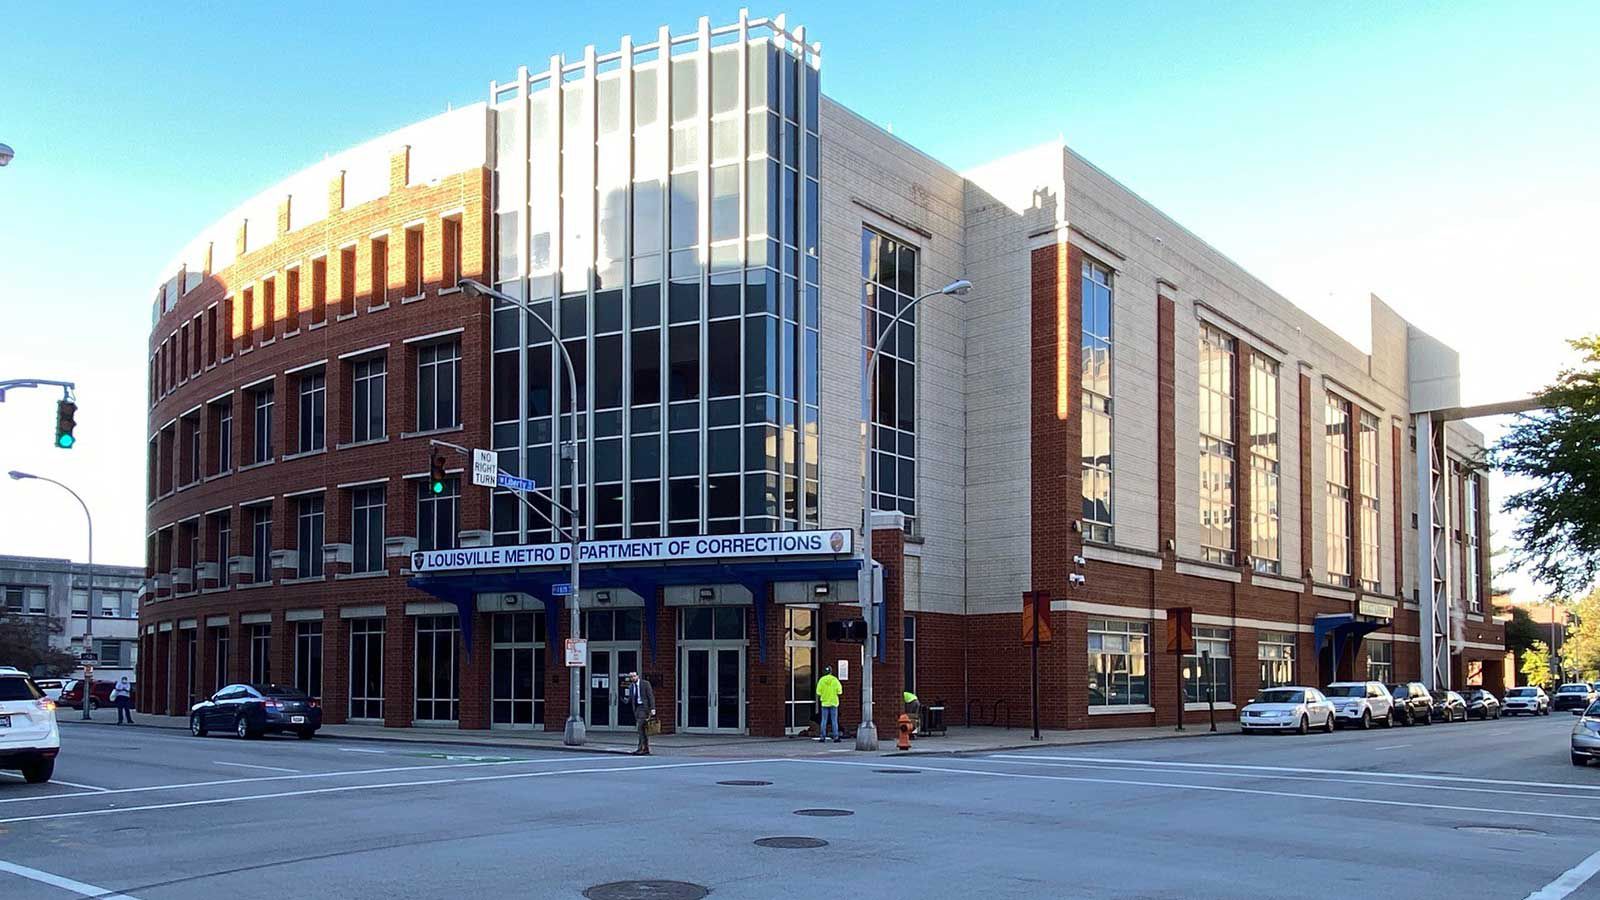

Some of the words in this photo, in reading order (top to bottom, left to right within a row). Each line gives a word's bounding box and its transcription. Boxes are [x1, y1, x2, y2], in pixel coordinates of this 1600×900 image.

[481, 452, 492, 462] NO
[475, 462, 496, 474] RIGHT
[476, 473, 496, 485] TURN
[505, 477, 528, 490] Liberty
[428, 550, 500, 567] LOUISVILLE
[505, 547, 555, 563] METRO
[560, 542, 663, 560] DPARTMENT
[668, 540, 690, 555] OF
[696, 535, 822, 554] CORRECTIONS
